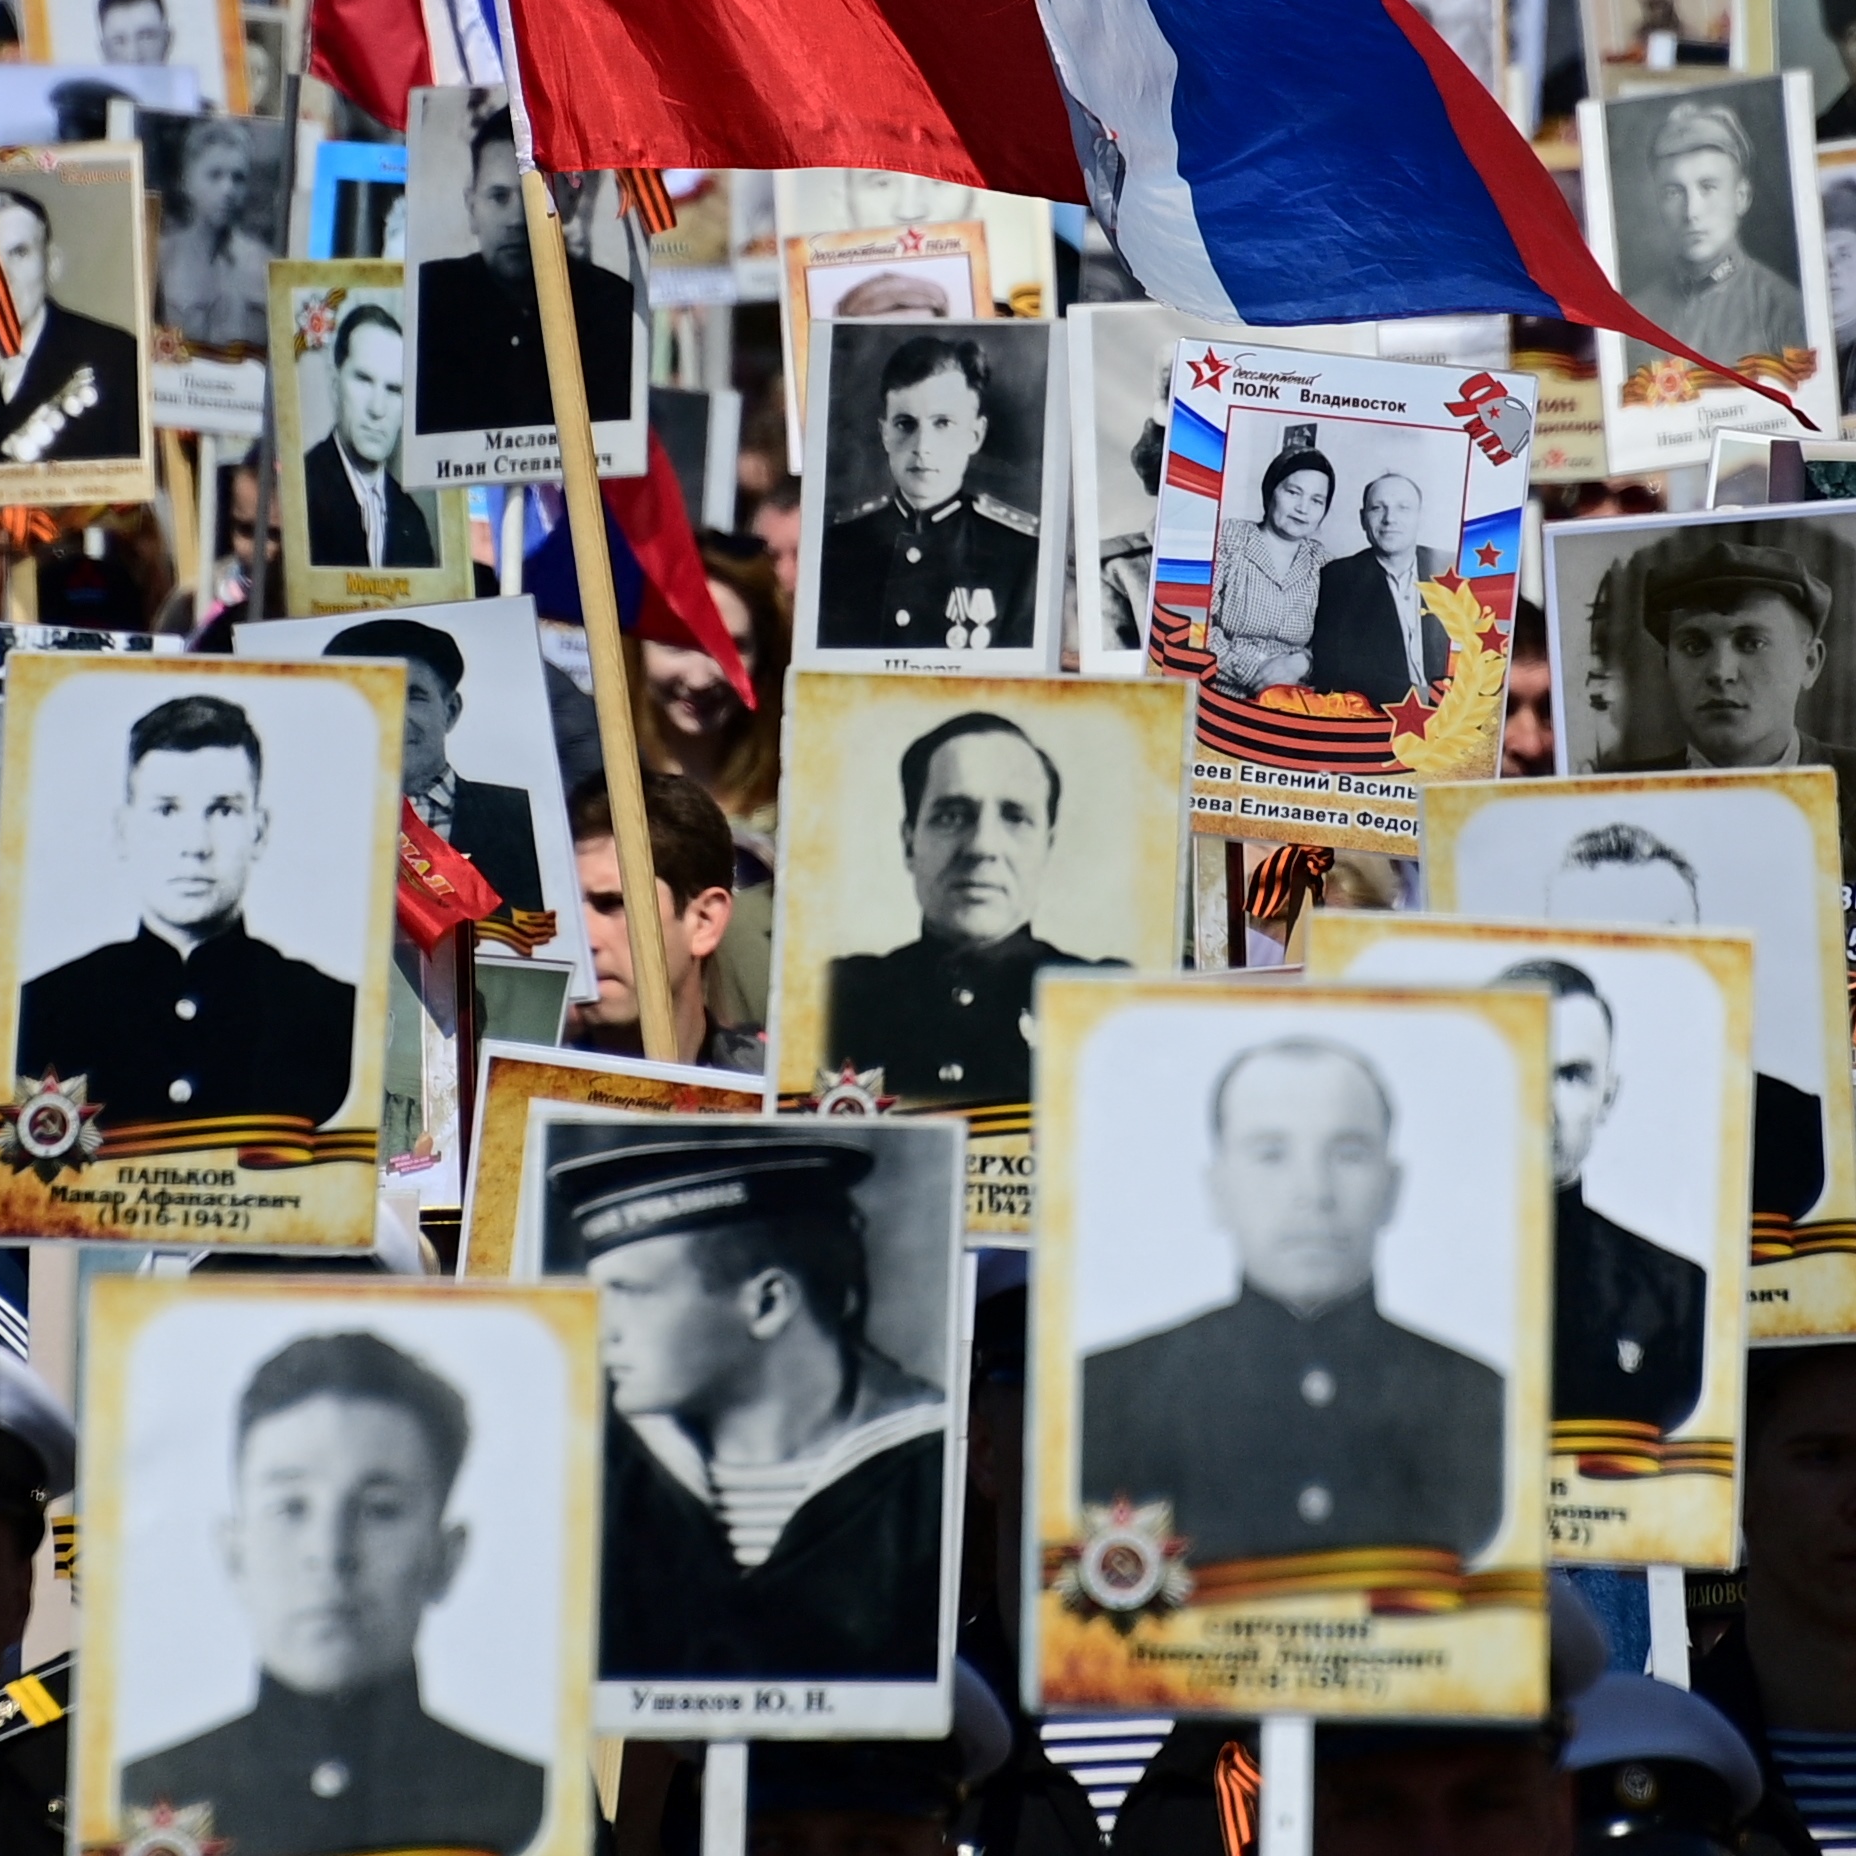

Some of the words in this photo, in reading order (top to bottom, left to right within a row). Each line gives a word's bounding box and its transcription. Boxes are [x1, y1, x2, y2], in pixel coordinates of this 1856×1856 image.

[1232, 382, 1280, 399] ПОЛК
[1300, 389, 1407, 413] Владивосток
[436, 459, 486, 480] Иван
[1240, 764, 1331, 791] Евгений
[1337, 775, 1420, 800] Василь
[1241, 797, 1349, 826] Елизавета
[116, 1167, 236, 1186] ПАНЬКОВ
[48, 1184, 126, 1206] Макар
[135, 1187, 302, 1211] Афанасьевич
[630, 1686, 744, 1713] Ушаков
[753, 1687, 795, 1713] Ю.
